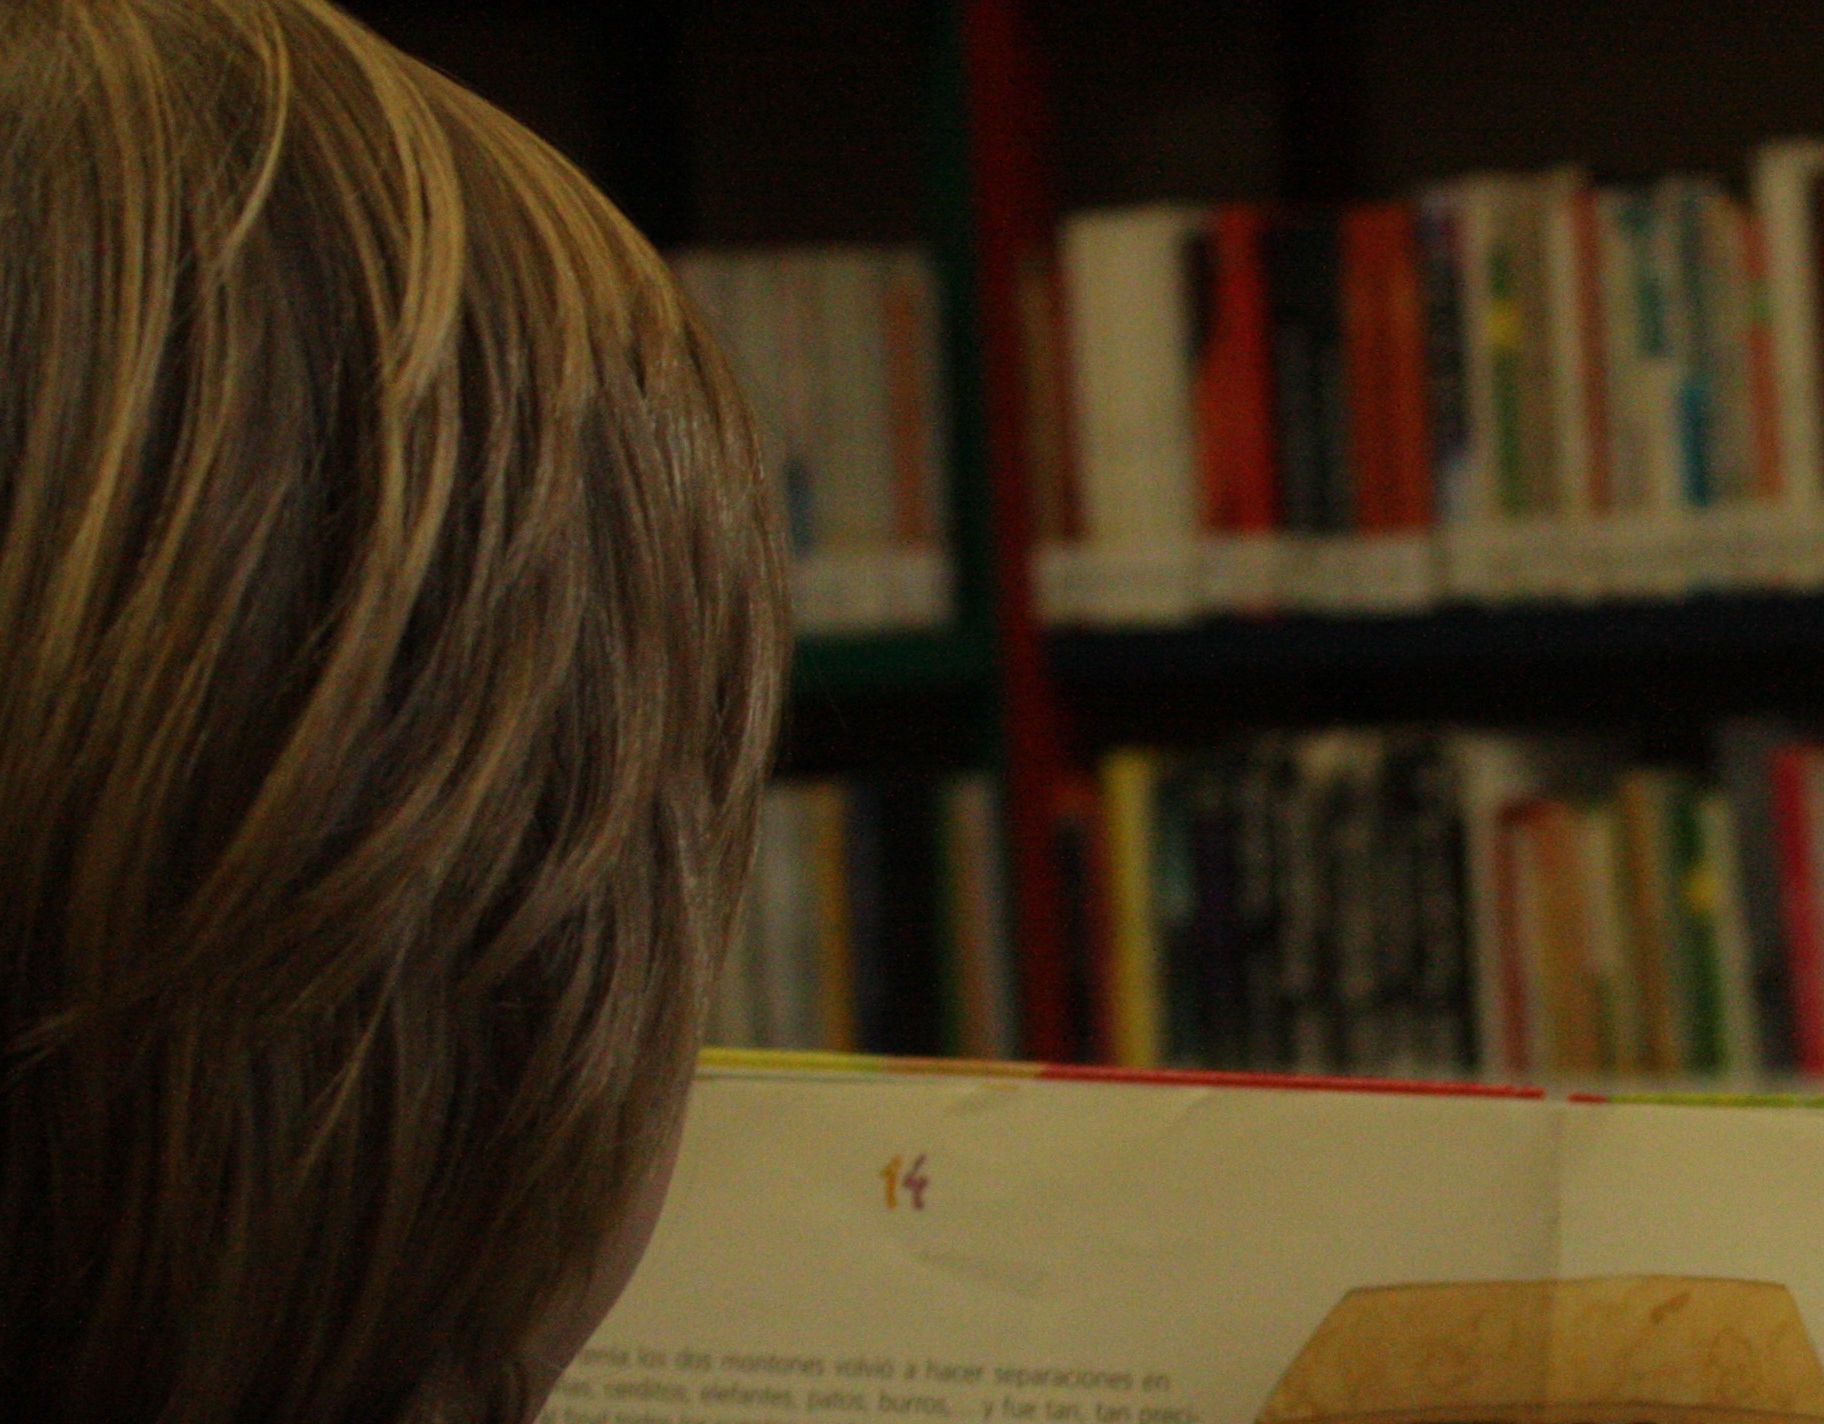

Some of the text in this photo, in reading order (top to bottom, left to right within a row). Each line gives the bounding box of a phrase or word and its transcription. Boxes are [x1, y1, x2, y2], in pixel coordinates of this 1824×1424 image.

[878, 1153, 928, 1211] 14
[720, 1353, 825, 1378] montones
[903, 1363, 917, 1381] a
[926, 1358, 983, 1384] hacer
[993, 1366, 1132, 1391] separaciones
[1142, 1374, 1171, 1392] en
[1002, 1395, 1037, 1419] fue
[1096, 1404, 1131, 1424] tan
